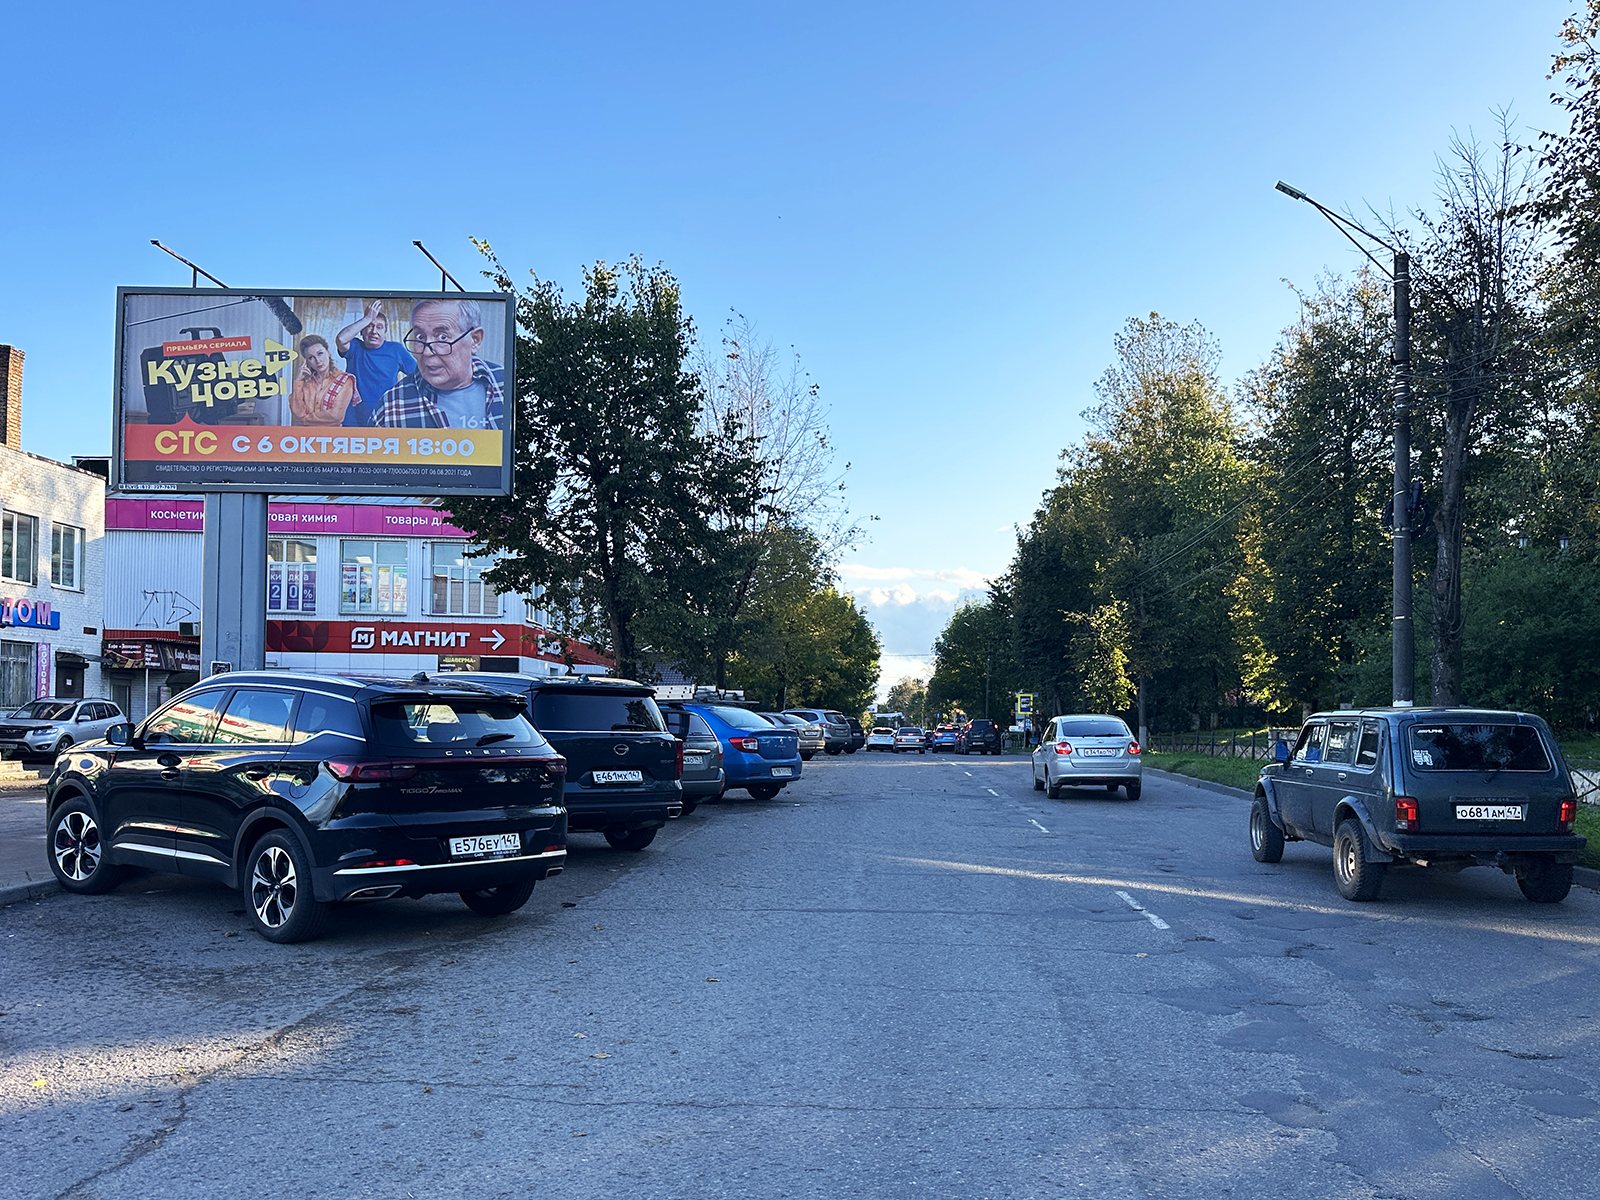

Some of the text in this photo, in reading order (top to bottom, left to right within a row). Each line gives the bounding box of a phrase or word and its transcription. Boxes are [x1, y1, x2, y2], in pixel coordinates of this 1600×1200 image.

[166, 341, 247, 352] ПРЕМЬЕРА СЕРИАЛА
[265, 350, 290, 363] ТВ
[147, 358, 262, 392] Кузне
[191, 377, 287, 408] цовы
[460, 416, 489, 429] 16+
[154, 430, 218, 455] СТС
[232, 435, 475, 457] С 6 ОКТЯБРЯ 18:00
[155, 464, 199, 472] СВИДЕТЕЛЬСТВО
[206, 465, 244, 473] РЕГИСТРАЦИИ
[301, 514, 338, 523] химия
[385, 515, 428, 526] товары
[381, 630, 471, 648] МАГНИТ
[1507, 807, 1517, 815] 47
[501, 835, 517, 845] 147
